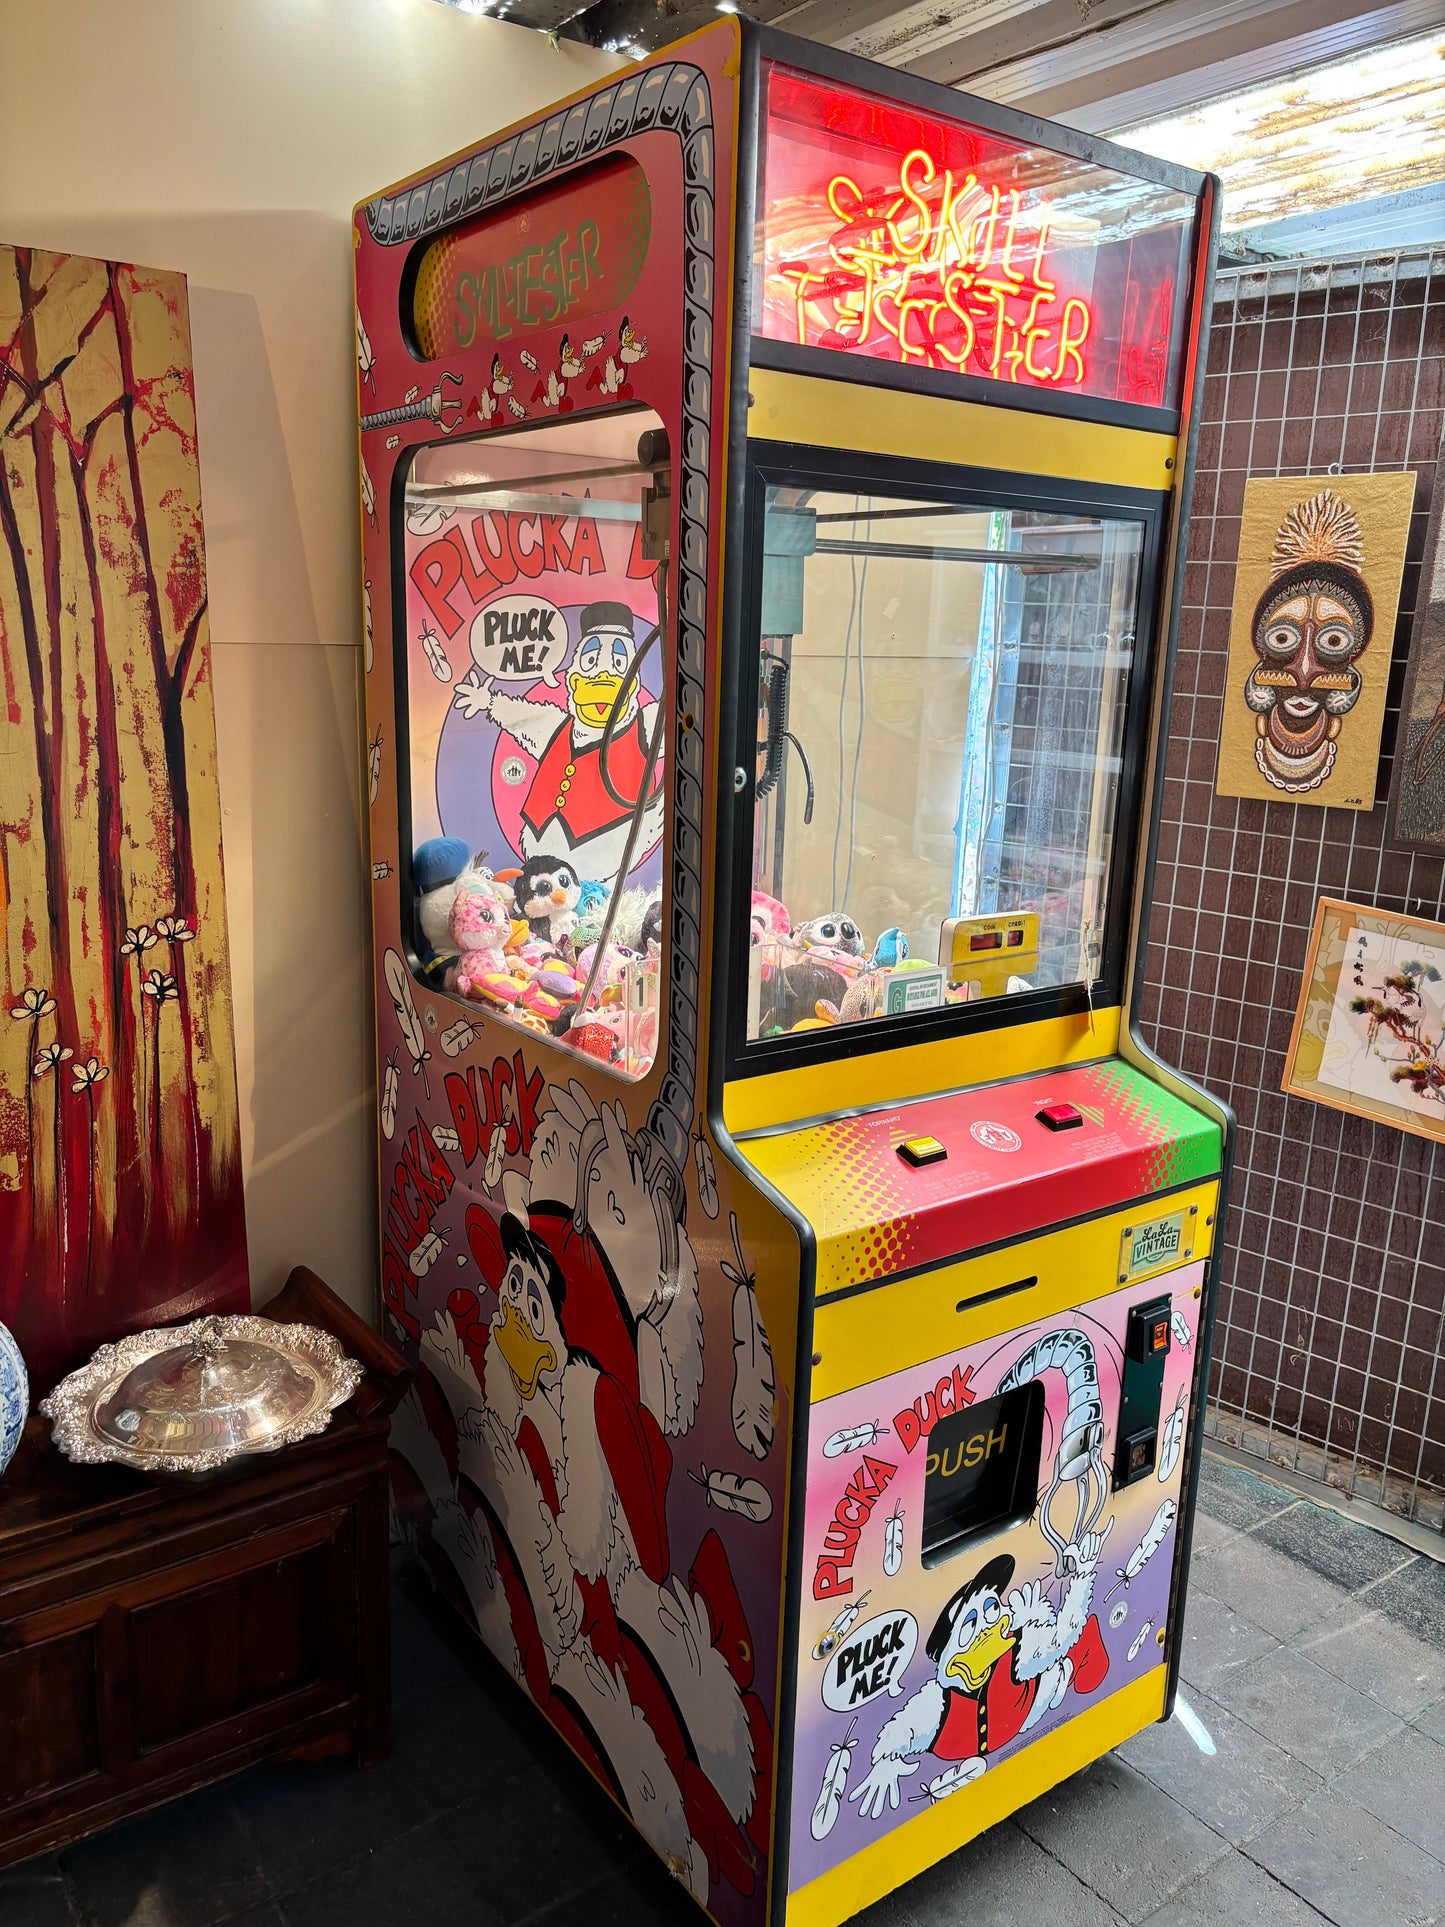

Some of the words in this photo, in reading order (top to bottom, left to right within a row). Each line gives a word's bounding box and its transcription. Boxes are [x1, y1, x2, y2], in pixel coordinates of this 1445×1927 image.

[886, 149, 1055, 290] SKILL
[838, 246, 1090, 383] TESTER
[409, 492, 607, 641] PLUCKA
[483, 608, 556, 647] PLUCK
[499, 643, 550, 673] ME!
[635, 976, 644, 1007] 1
[891, 988, 902, 1014] G
[383, 1106, 456, 1345] PLUCKA
[443, 1048, 546, 1169] DUCK
[1136, 1234, 1177, 1259] VINTAGE
[925, 1423, 1008, 1478] PUSH
[813, 1455, 898, 1600] PLUCKA
[893, 1364, 977, 1453] DUCK
[837, 1617, 908, 1688] PLUCK
[849, 1655, 899, 1705] ME!
